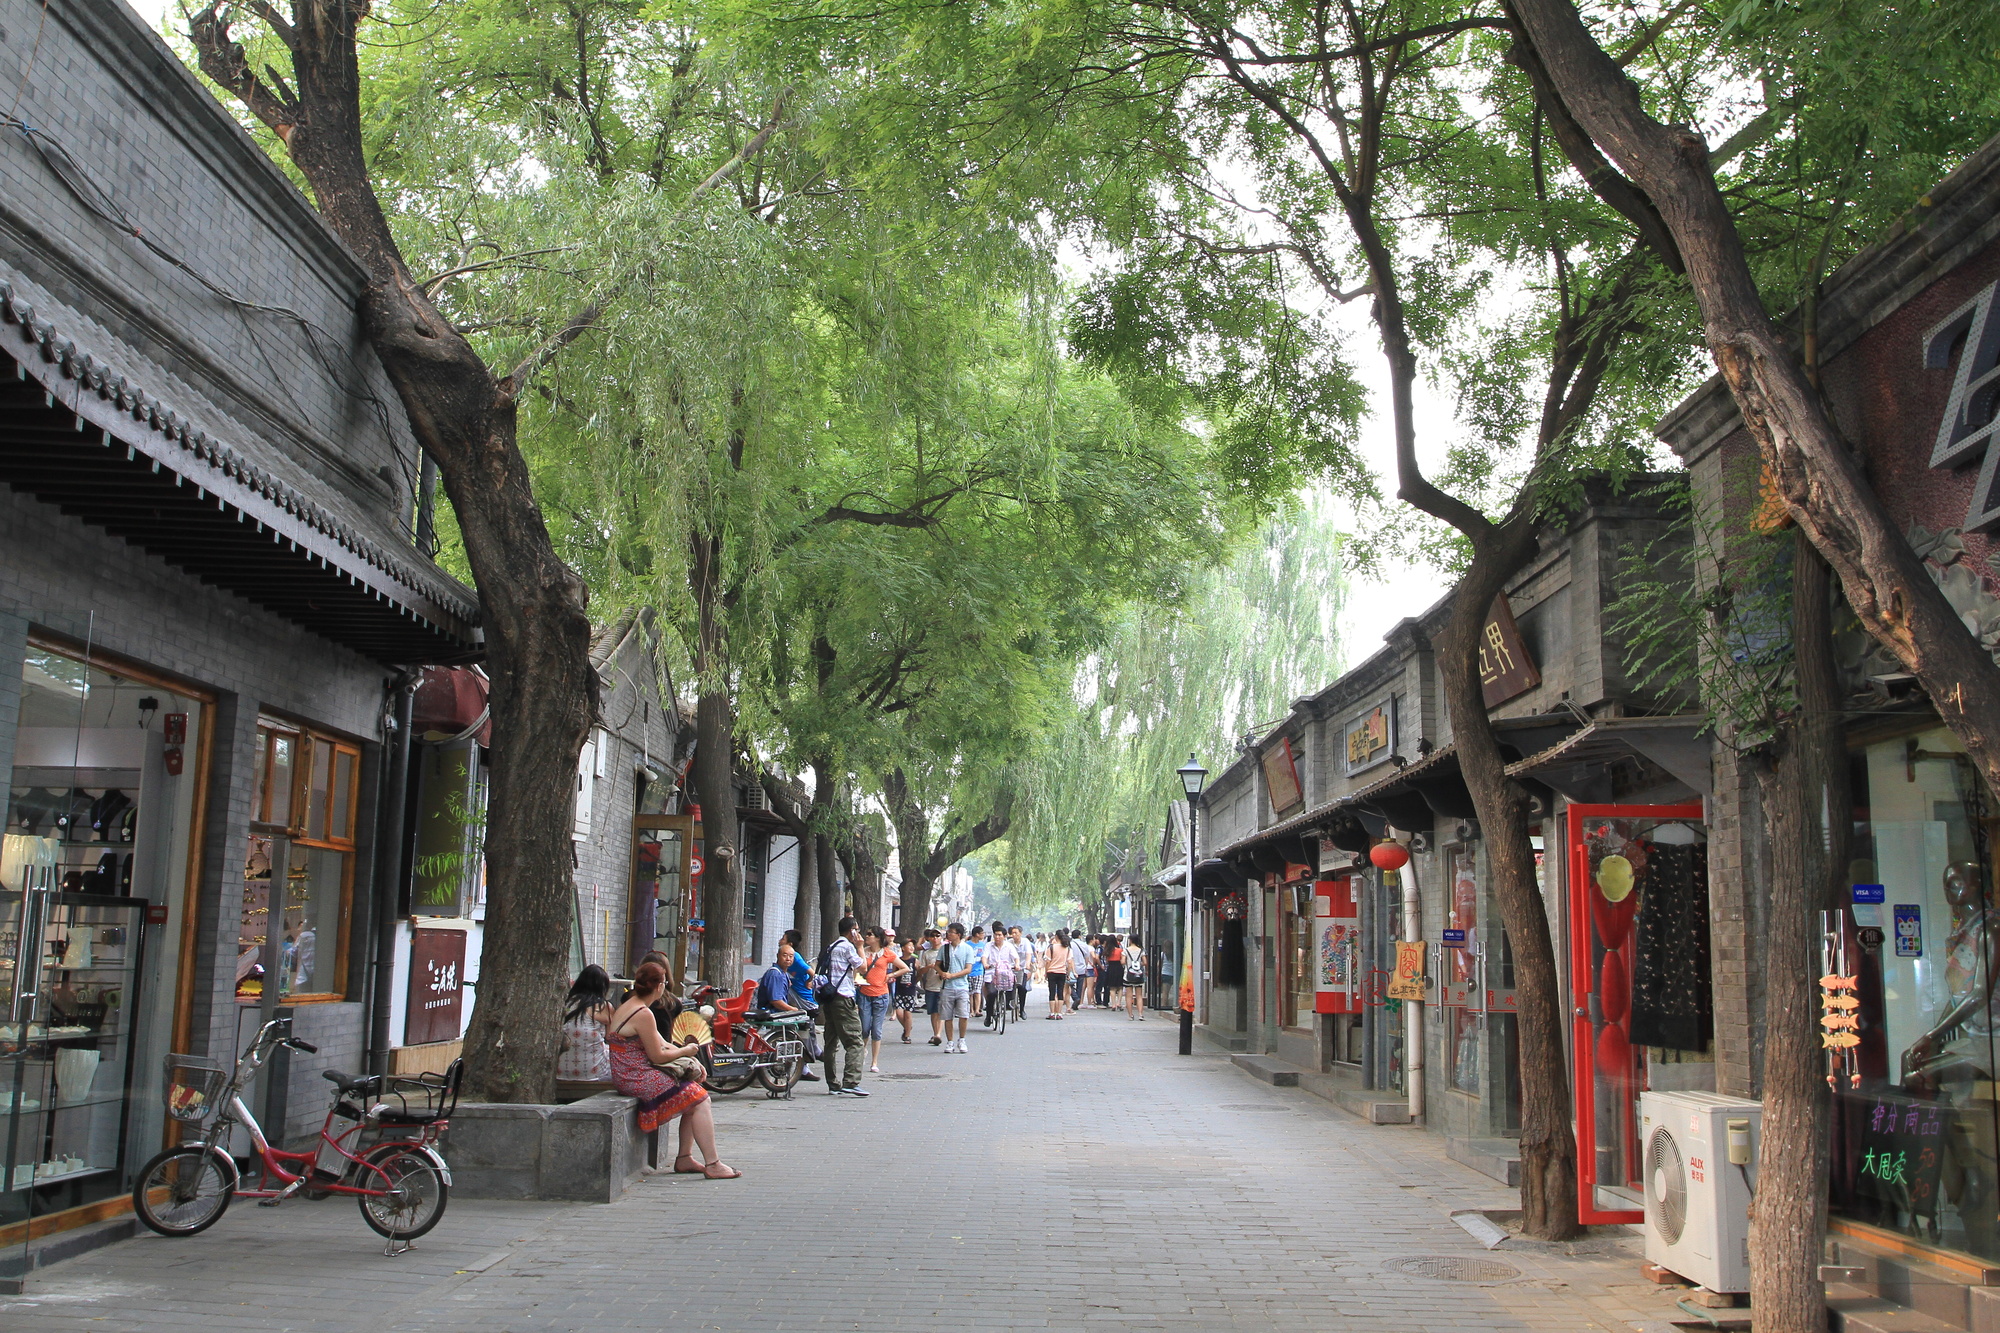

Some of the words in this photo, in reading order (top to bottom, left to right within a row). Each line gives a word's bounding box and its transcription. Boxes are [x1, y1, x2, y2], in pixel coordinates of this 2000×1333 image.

[1690, 1156, 1704, 1170] AUX
[1861, 1147, 1907, 1184] 大甩卖
